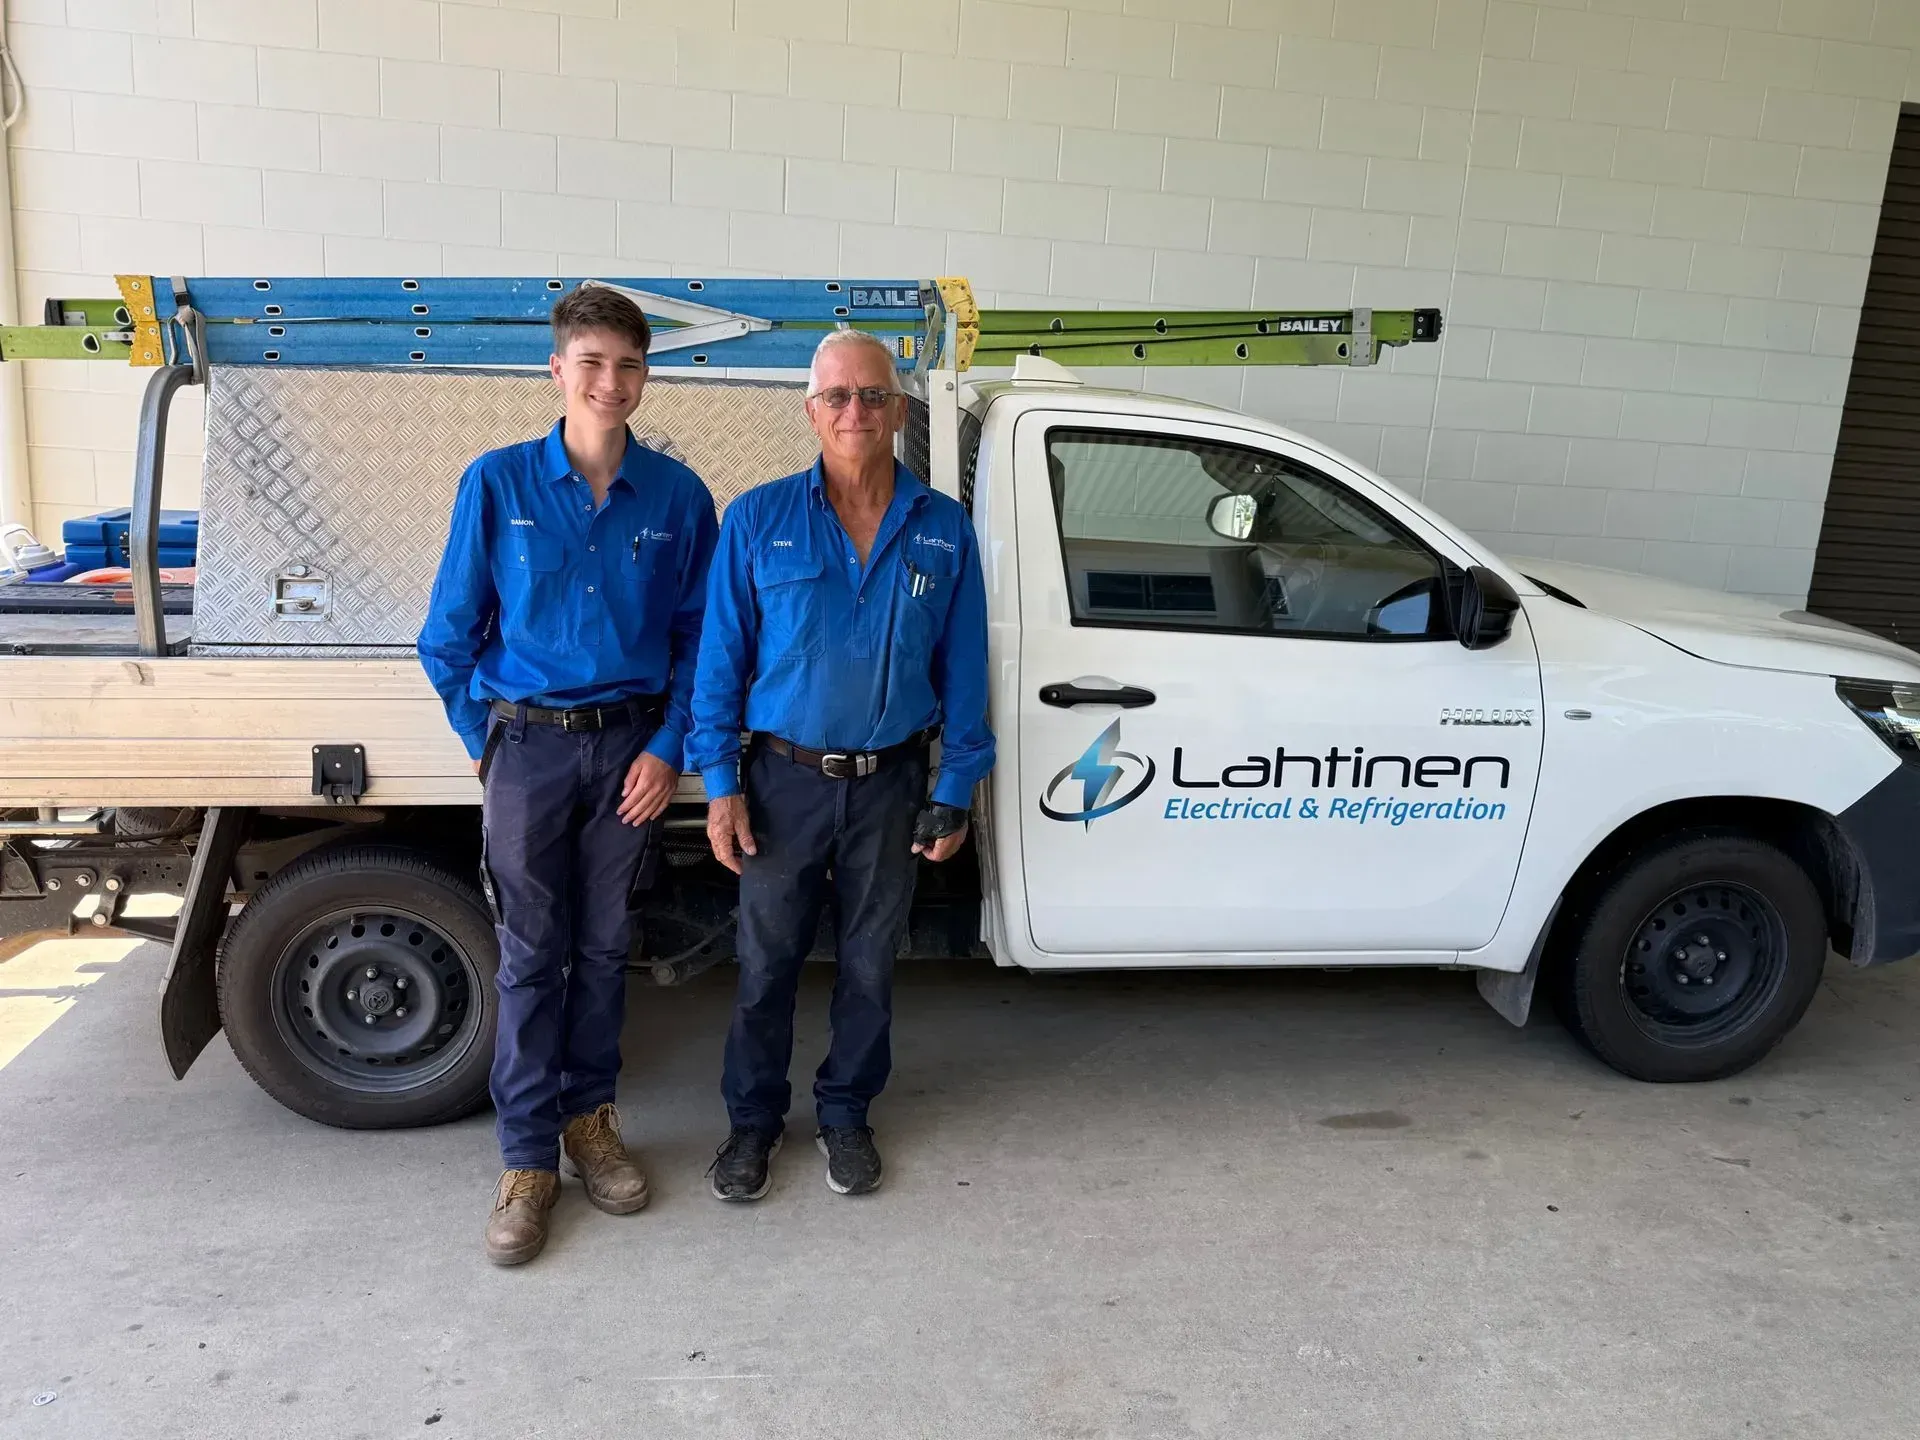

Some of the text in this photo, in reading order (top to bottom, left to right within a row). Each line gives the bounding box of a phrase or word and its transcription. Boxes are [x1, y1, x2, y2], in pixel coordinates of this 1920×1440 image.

[853, 290, 919, 306] BAILE
[1280, 319, 1341, 332] BAILEY
[1440, 708, 1534, 726] HILUX
[1172, 746, 1510, 789] Lahtinen
[1163, 796, 1507, 827] Electrical & Refrigeration
